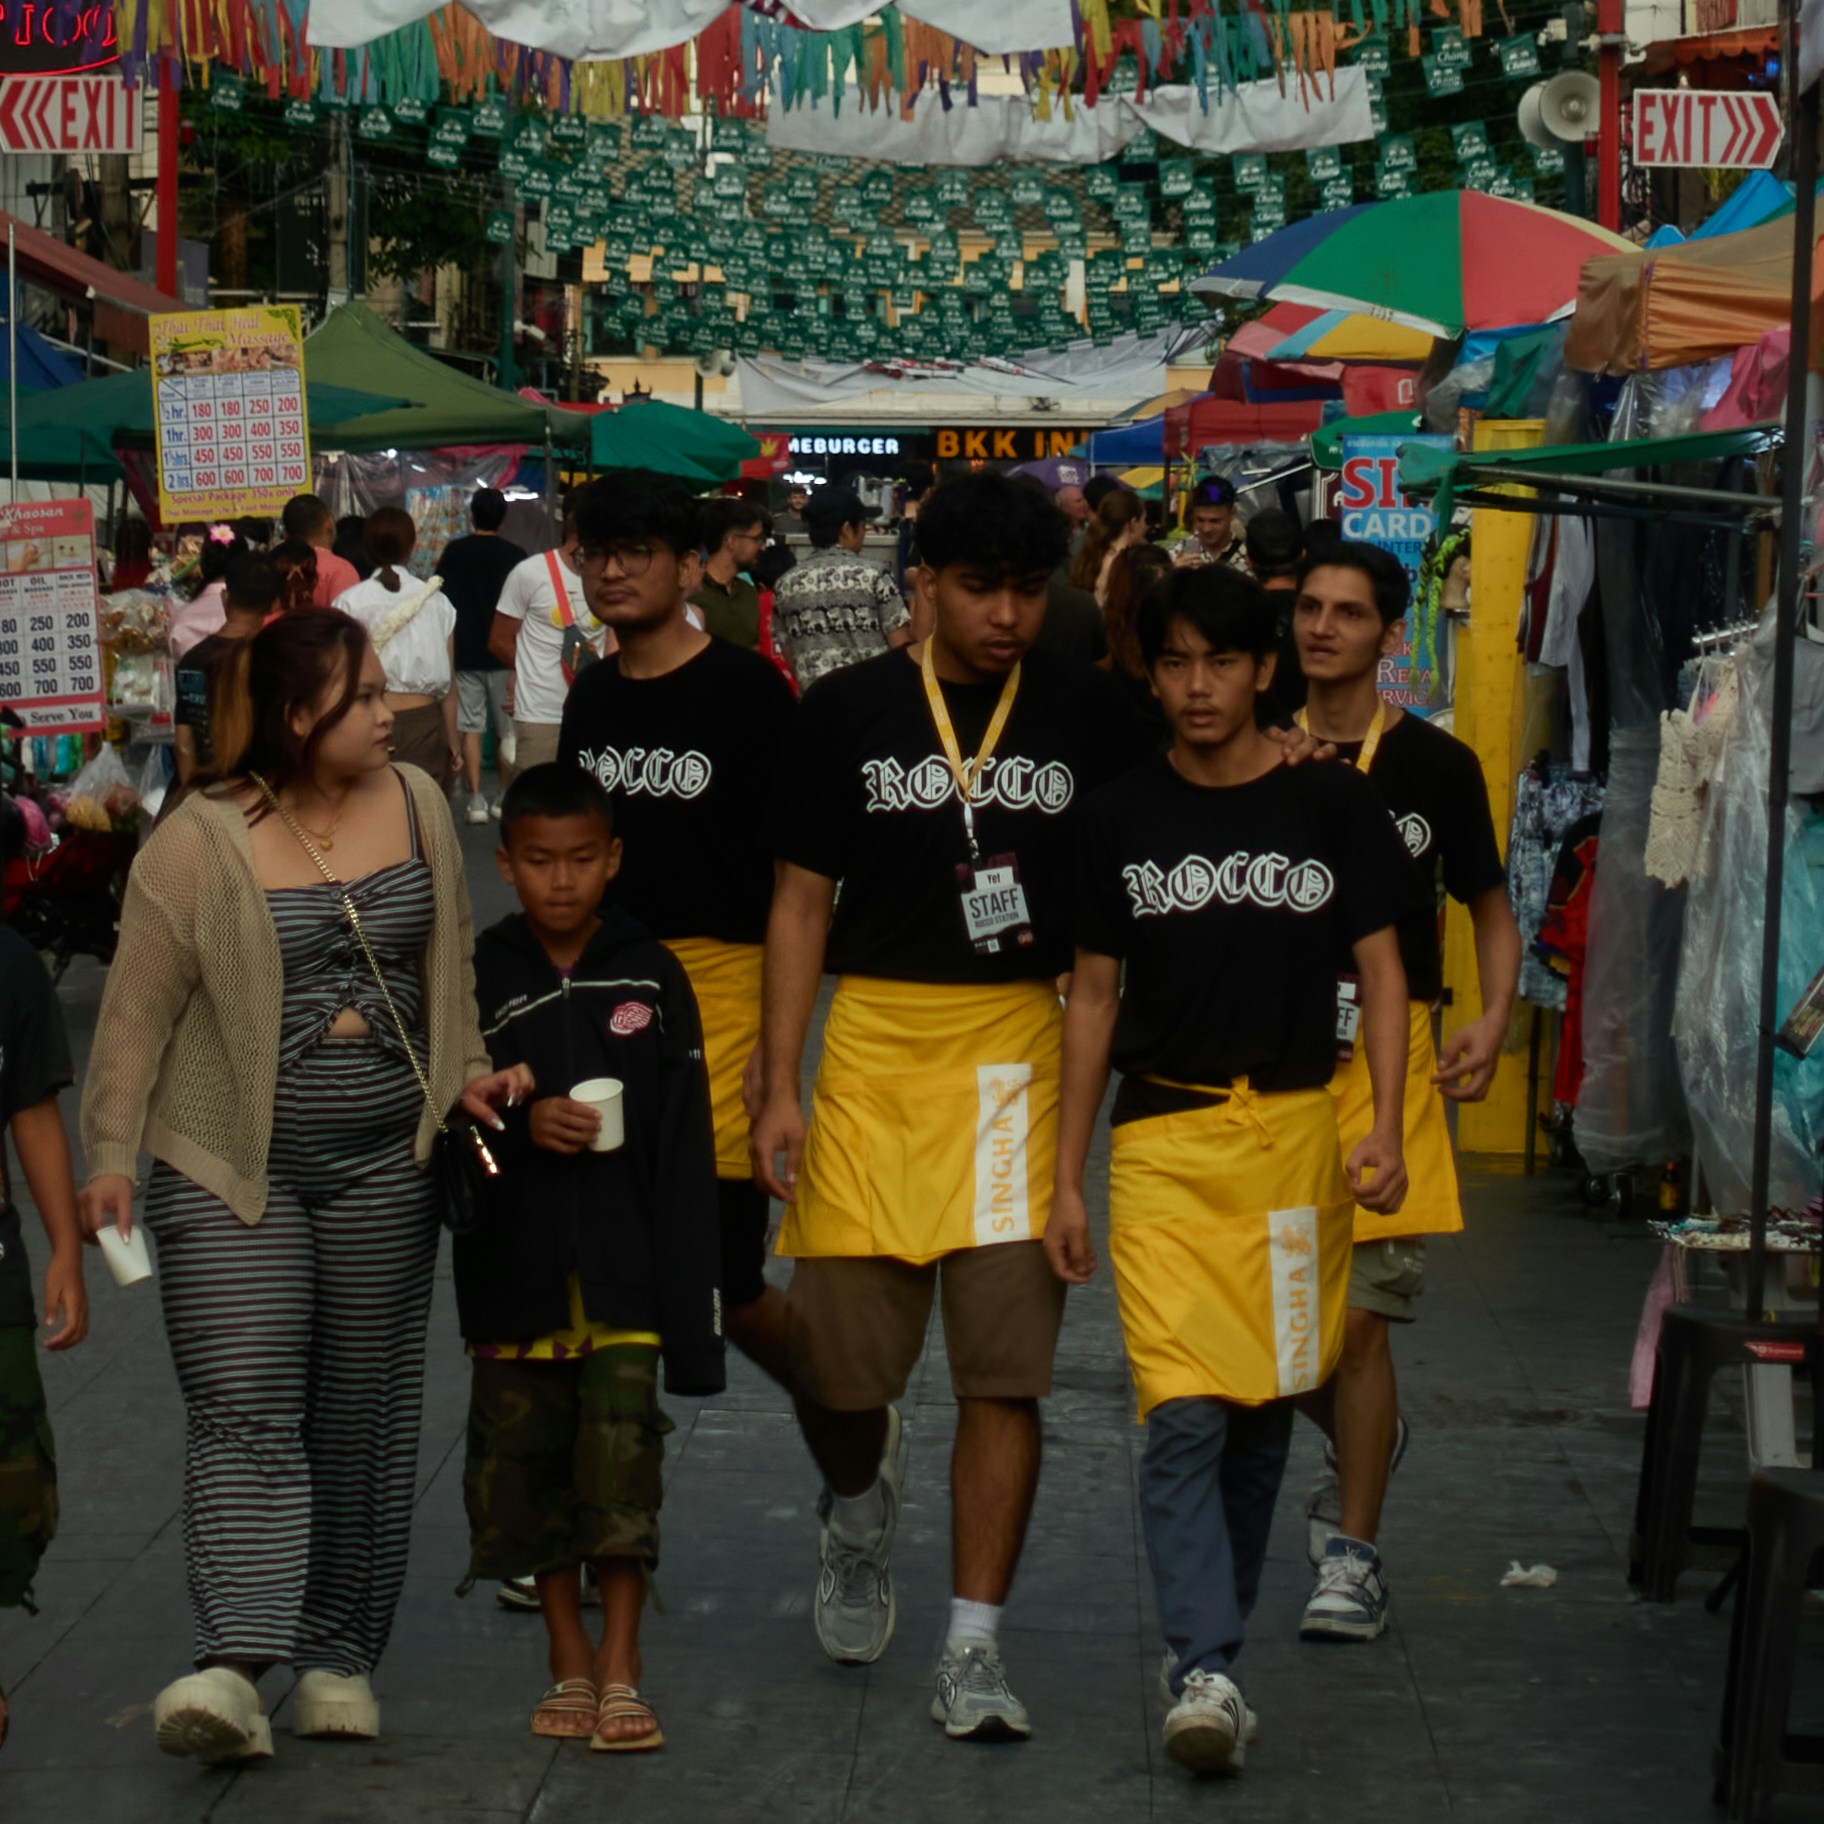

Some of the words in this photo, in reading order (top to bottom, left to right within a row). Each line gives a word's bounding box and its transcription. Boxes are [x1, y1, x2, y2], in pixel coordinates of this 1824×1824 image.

[61, 80, 140, 150] EXIT
[1638, 94, 1718, 164] EXIT
[192, 403, 212, 418] 180
[221, 402, 241, 416] 180
[250, 399, 270, 414] 250
[278, 397, 298, 412] 200
[193, 426, 213, 441] 300
[222, 424, 242, 439] 300
[250, 422, 271, 437] 400
[279, 420, 300, 435] 350
[194, 448, 214, 463] 450
[223, 446, 243, 461] 450
[252, 444, 272, 459] 550
[280, 442, 301, 458] 550
[936, 429, 1019, 460] BKK
[1033, 429, 1090, 459] IN
[196, 471, 216, 486] 600
[224, 469, 245, 484] 600
[254, 467, 274, 482] 700
[282, 466, 302, 481] 700
[171, 494, 206, 506] Special
[208, 490, 247, 505] Package
[276, 487, 297, 499] only
[23, 522, 45, 536] Spa
[1342, 512, 1434, 540] CARD
[30, 576, 46, 585] OIL
[30, 615, 53, 632] 250
[66, 612, 89, 629] 200
[31, 636, 55, 653] 400
[67, 633, 91, 650] 350
[32, 657, 56, 674] 550
[68, 654, 92, 671] 550
[34, 678, 58, 695] 700
[70, 675, 94, 692] 700
[30, 709, 65, 725] Serve
[69, 707, 94, 721] You
[862, 754, 1075, 814] ROCCO
[1122, 851, 1335, 918] ROCCO
[969, 887, 1019, 919] STAFF
[995, 911, 1020, 925] STATION
[992, 1115, 1016, 1233] SINGHA
[1289, 1265, 1310, 1390] SINGHA
